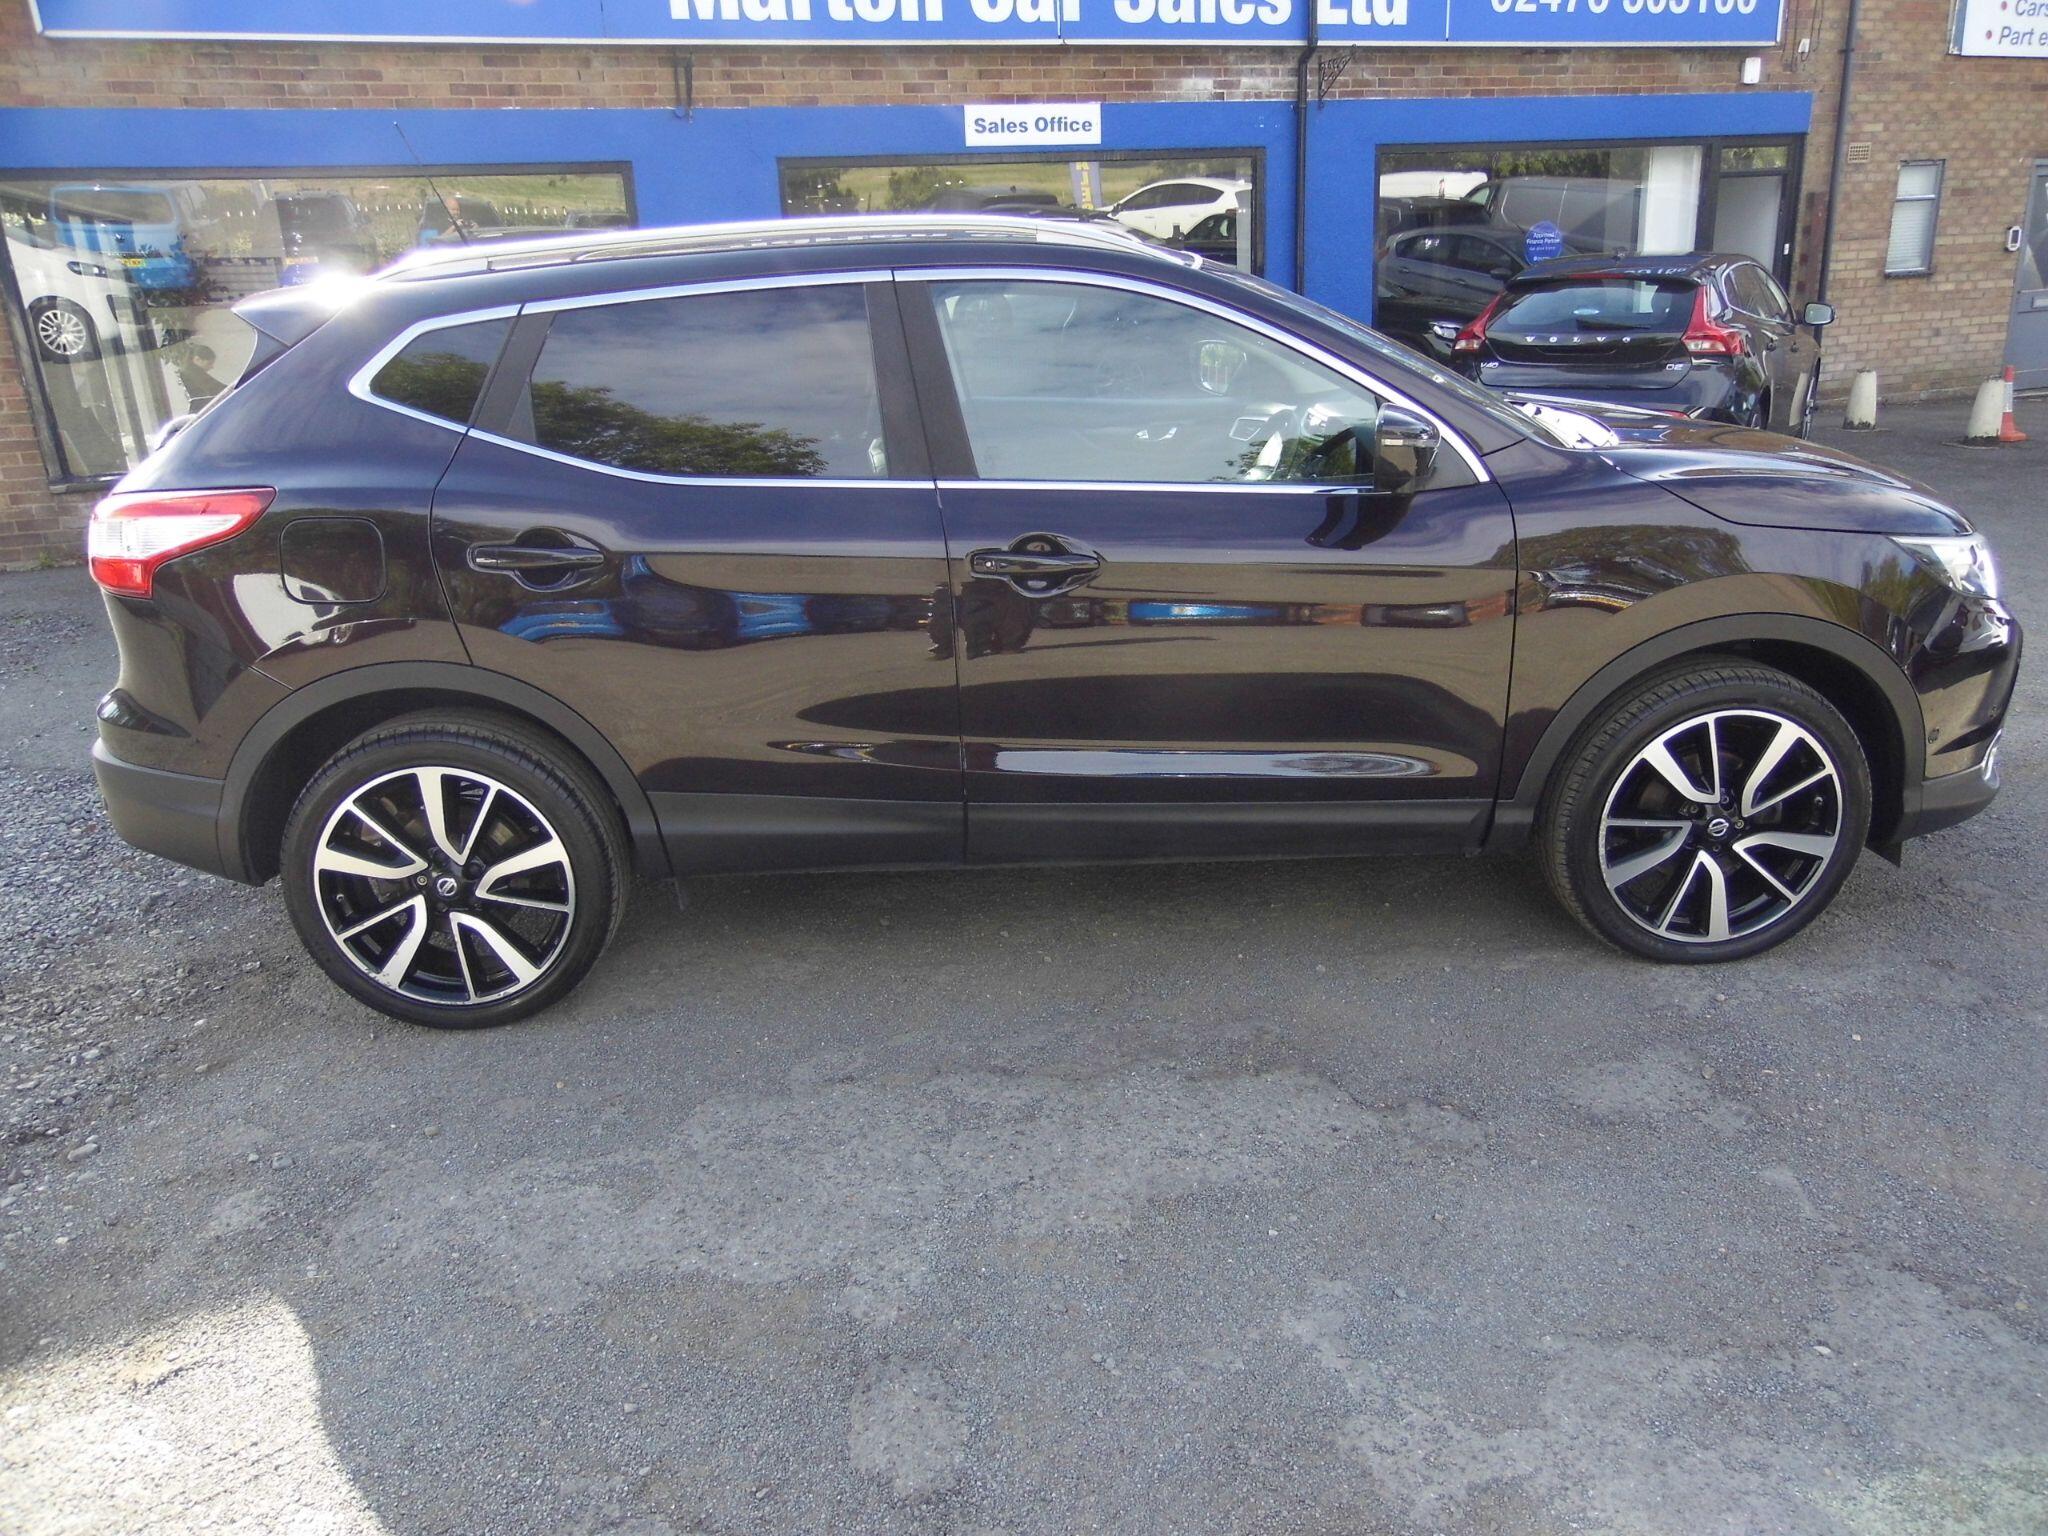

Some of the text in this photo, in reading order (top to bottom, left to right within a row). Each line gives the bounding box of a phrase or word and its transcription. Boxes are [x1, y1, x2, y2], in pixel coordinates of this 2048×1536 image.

[1998, 26, 2034, 46] Part
[974, 116, 1093, 134] Sales Office
[1525, 336, 1631, 344] VOLVO
[1480, 361, 1499, 370] V40
